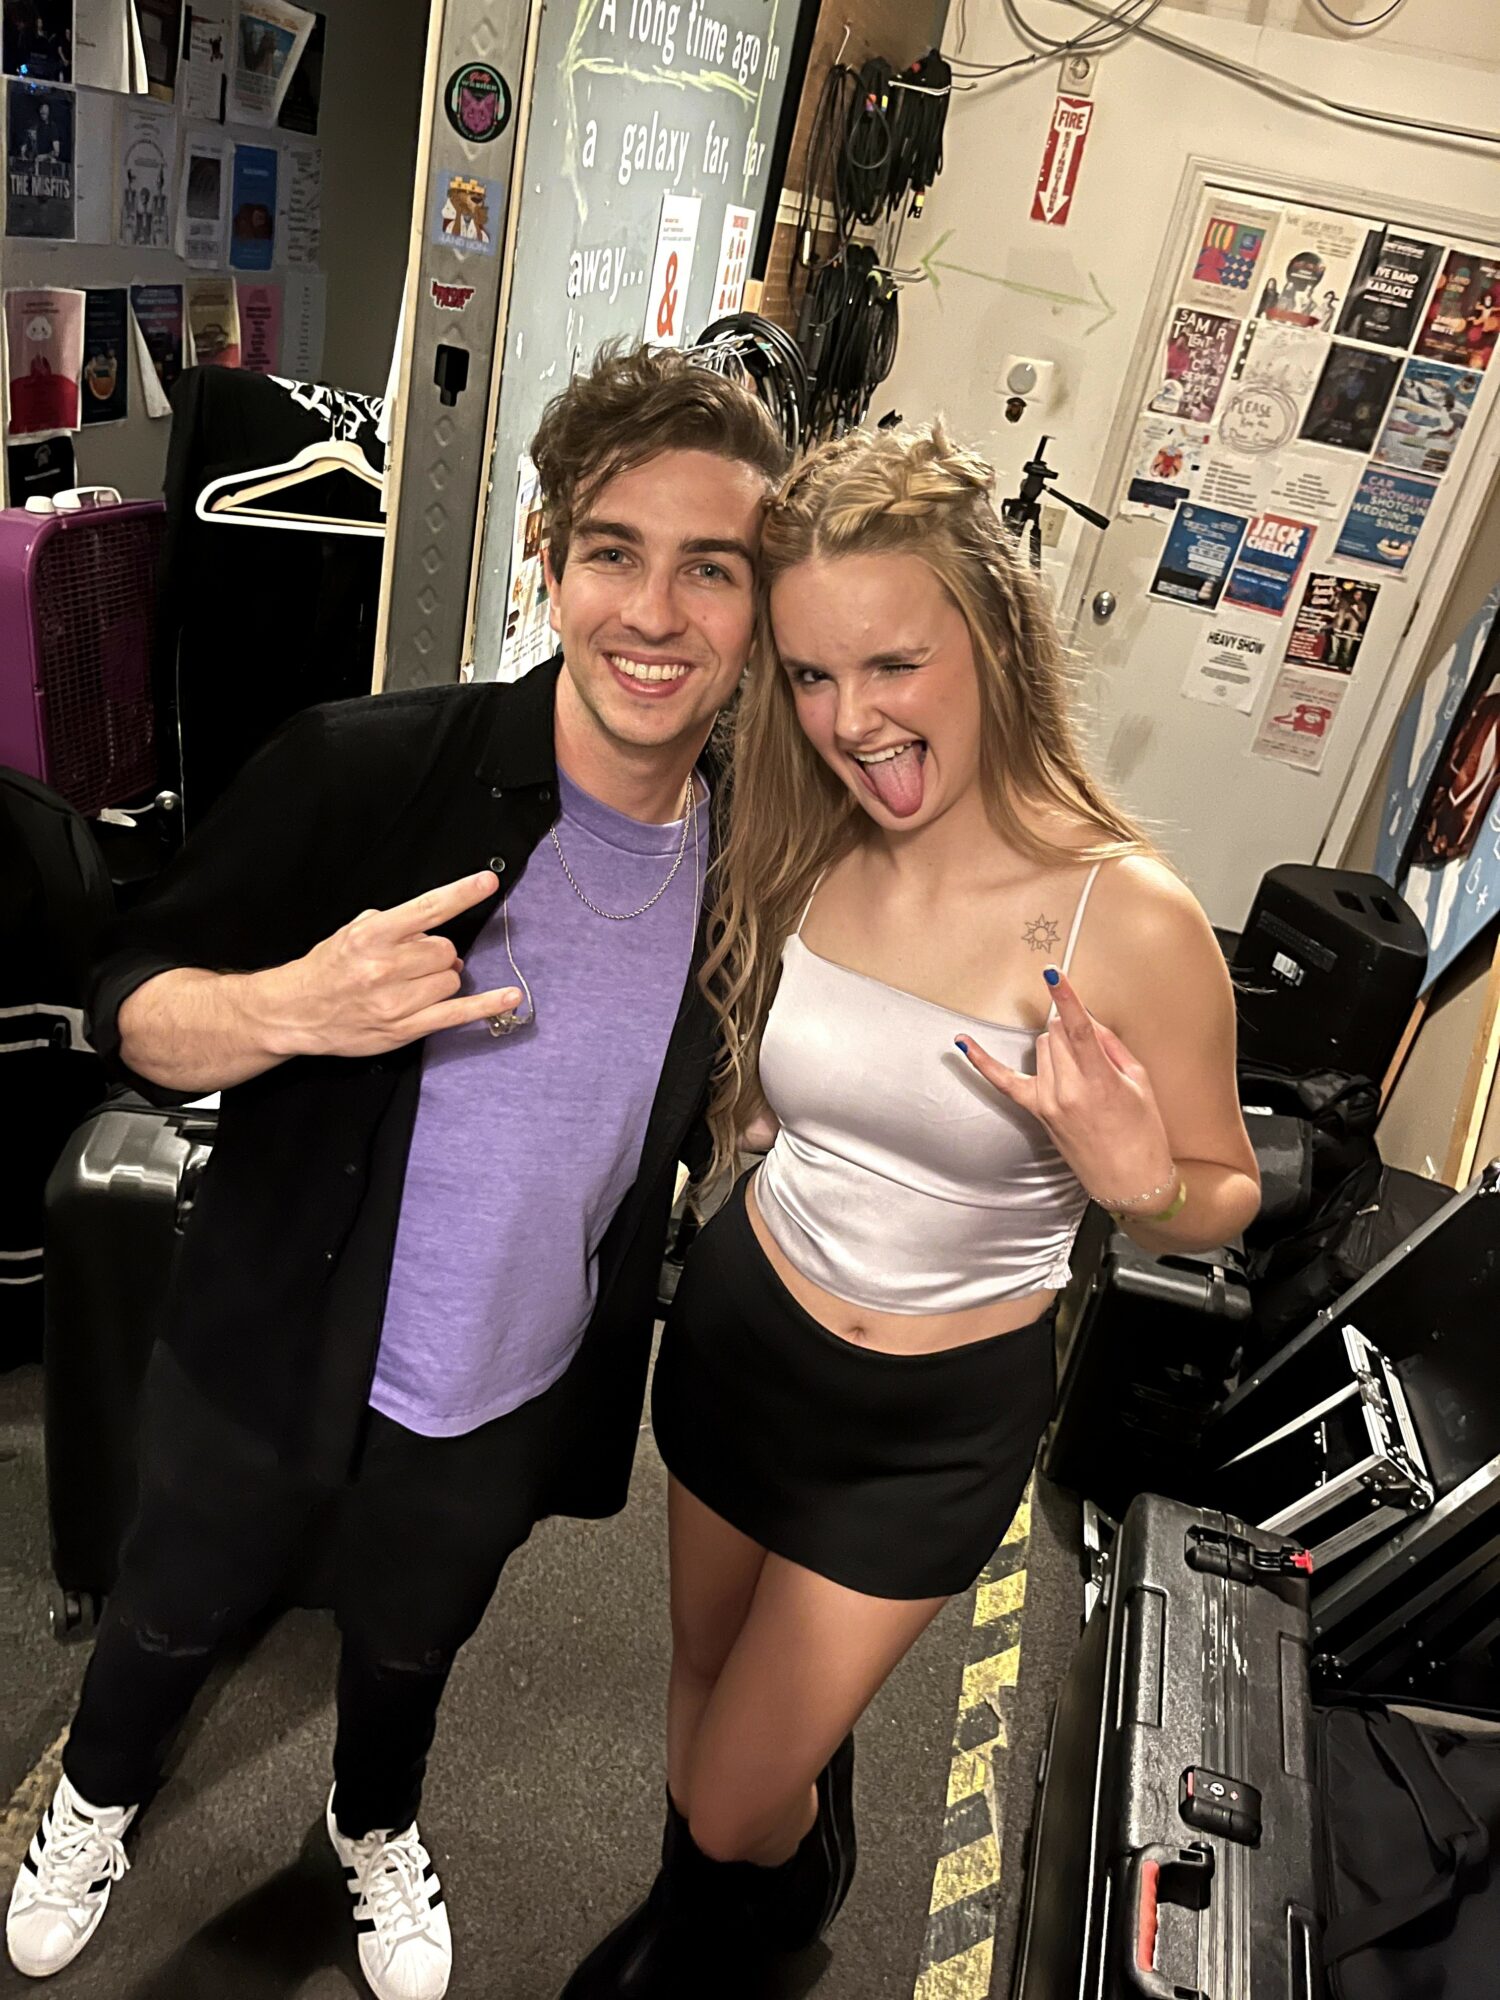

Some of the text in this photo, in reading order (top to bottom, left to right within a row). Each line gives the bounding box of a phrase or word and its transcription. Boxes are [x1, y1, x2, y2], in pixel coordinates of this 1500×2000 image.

[598, 0, 780, 86] A long time ago in
[1058, 110, 1086, 130] FIRE
[582, 110, 766, 186] a galaxy far, far
[10, 174, 71, 199] THE MISFITS
[567, 247, 644, 305] away...
[1374, 266, 1420, 284] IVE BAND
[1365, 279, 1415, 299] KARAOKE
[1180, 310, 1211, 334] SAM
[1231, 396, 1272, 418] PLEASE
[1352, 503, 1409, 523] WEDDING
[1370, 496, 1426, 516] SHOTGUN
[1251, 518, 1304, 547] JACK
[1374, 518, 1420, 536] SINGER
[1206, 631, 1237, 650] HEAVY
[1236, 638, 1266, 656] SHOW
